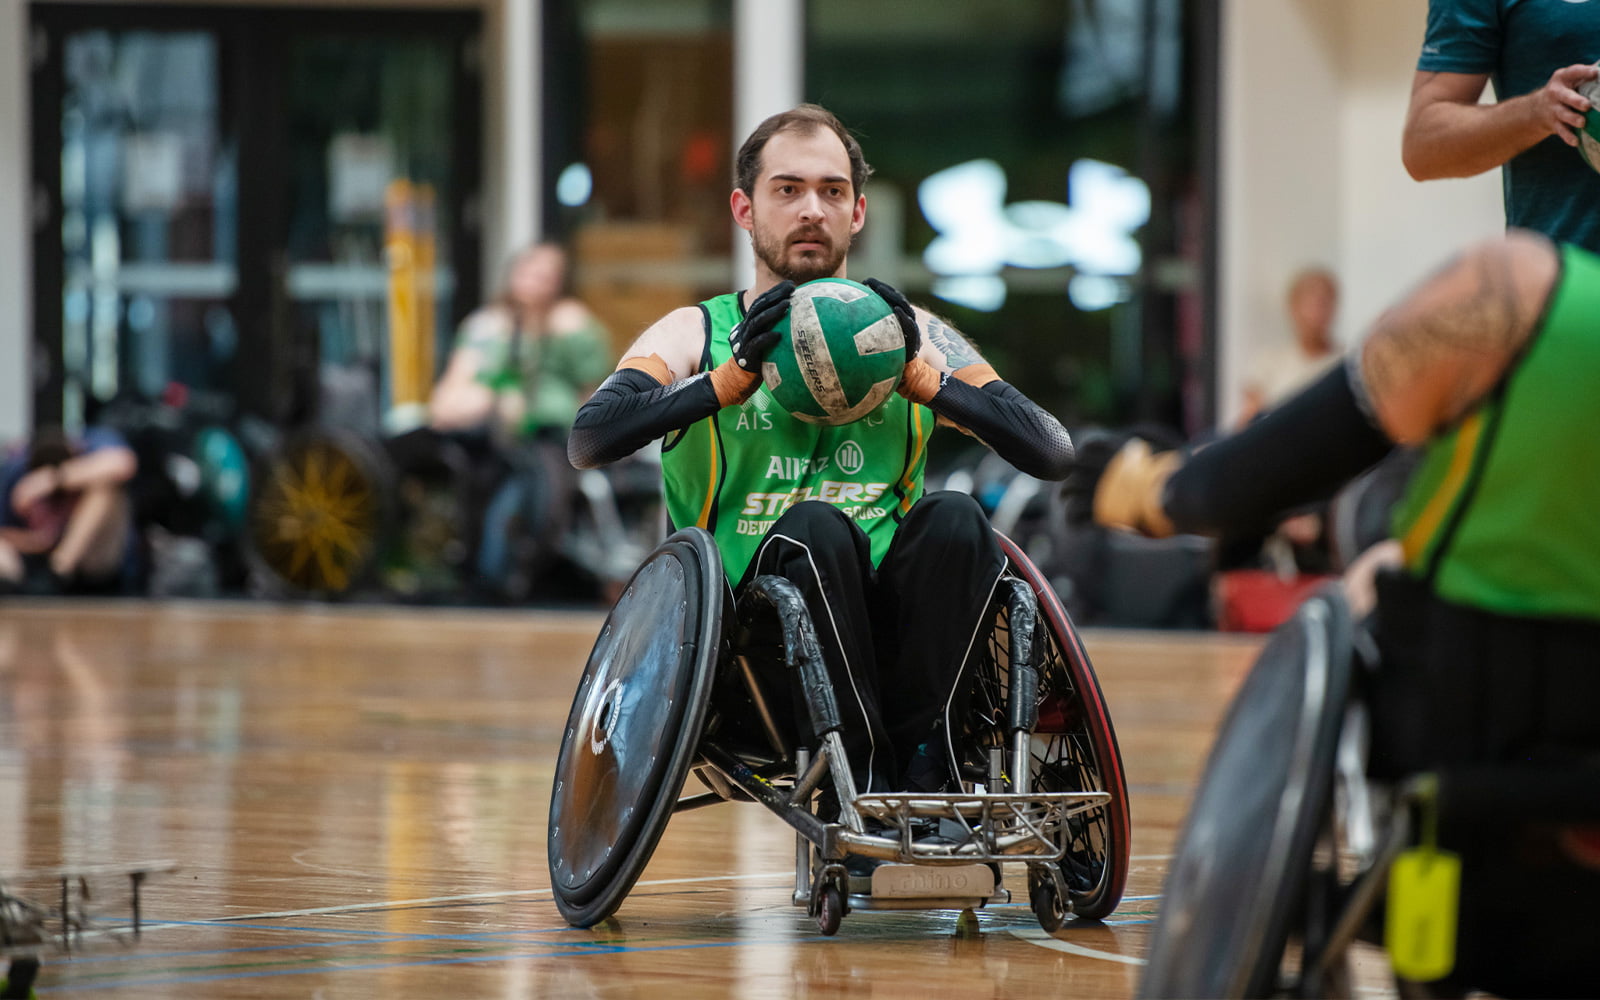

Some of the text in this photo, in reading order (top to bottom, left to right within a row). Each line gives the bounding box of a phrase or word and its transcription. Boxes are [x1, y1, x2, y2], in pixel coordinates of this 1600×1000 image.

[797, 329, 825, 393] STEELERS
[736, 412, 773, 431] AIS
[765, 455, 829, 480] Allanz
